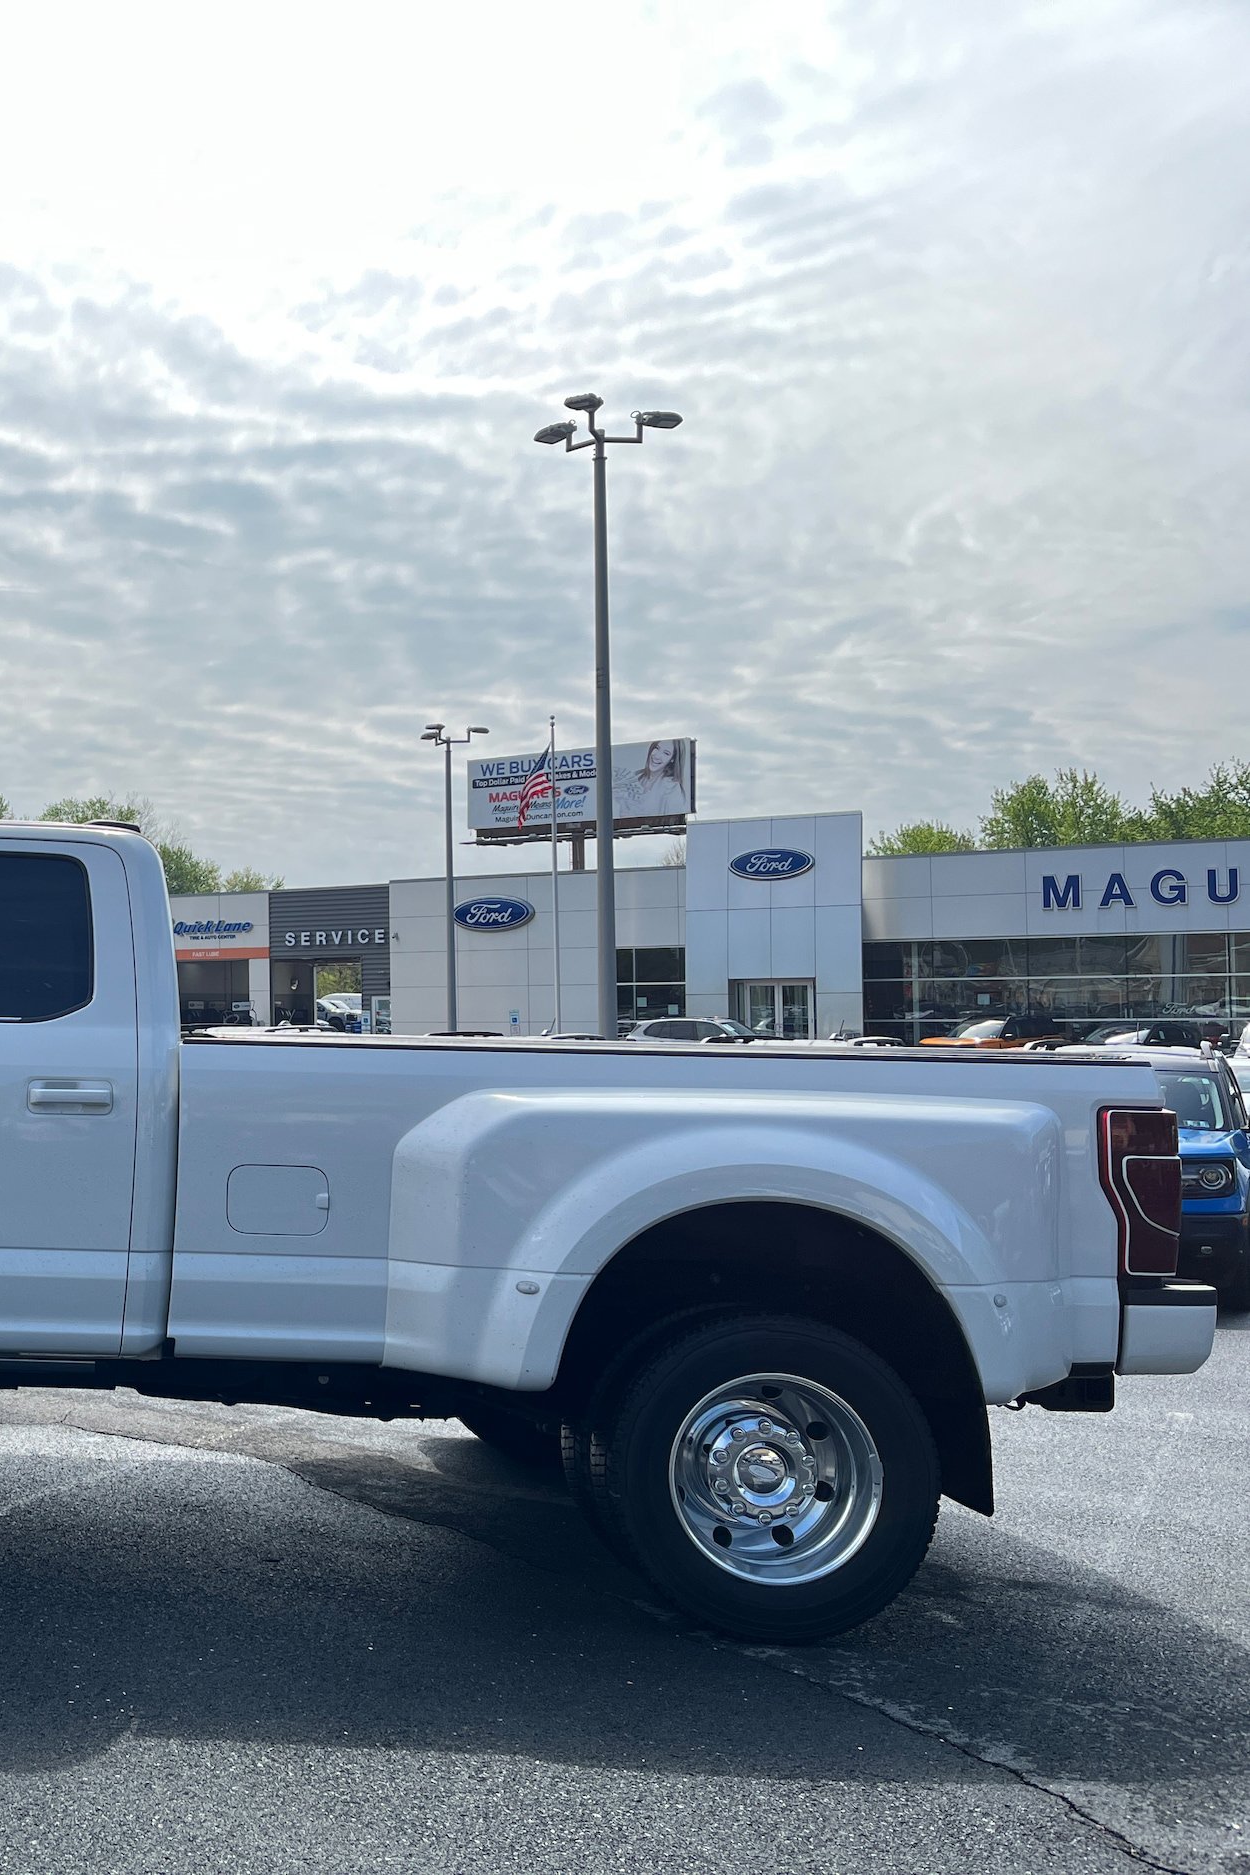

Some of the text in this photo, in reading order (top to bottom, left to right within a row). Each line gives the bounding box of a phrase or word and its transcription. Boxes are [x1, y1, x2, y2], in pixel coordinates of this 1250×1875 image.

[480, 762, 505, 777] WE
[547, 753, 594, 770] CARS
[475, 779, 490, 788] Top
[490, 778, 509, 786] Dollar
[509, 776, 525, 784] Paid
[493, 803, 519, 814] Maguir
[746, 853, 793, 872] Ford
[1041, 866, 1241, 910] MAGU
[466, 903, 513, 923] Ford
[173, 920, 253, 936] Quick Lane
[284, 929, 385, 947] SERVICE
[1162, 1002, 1197, 1015] Ford
